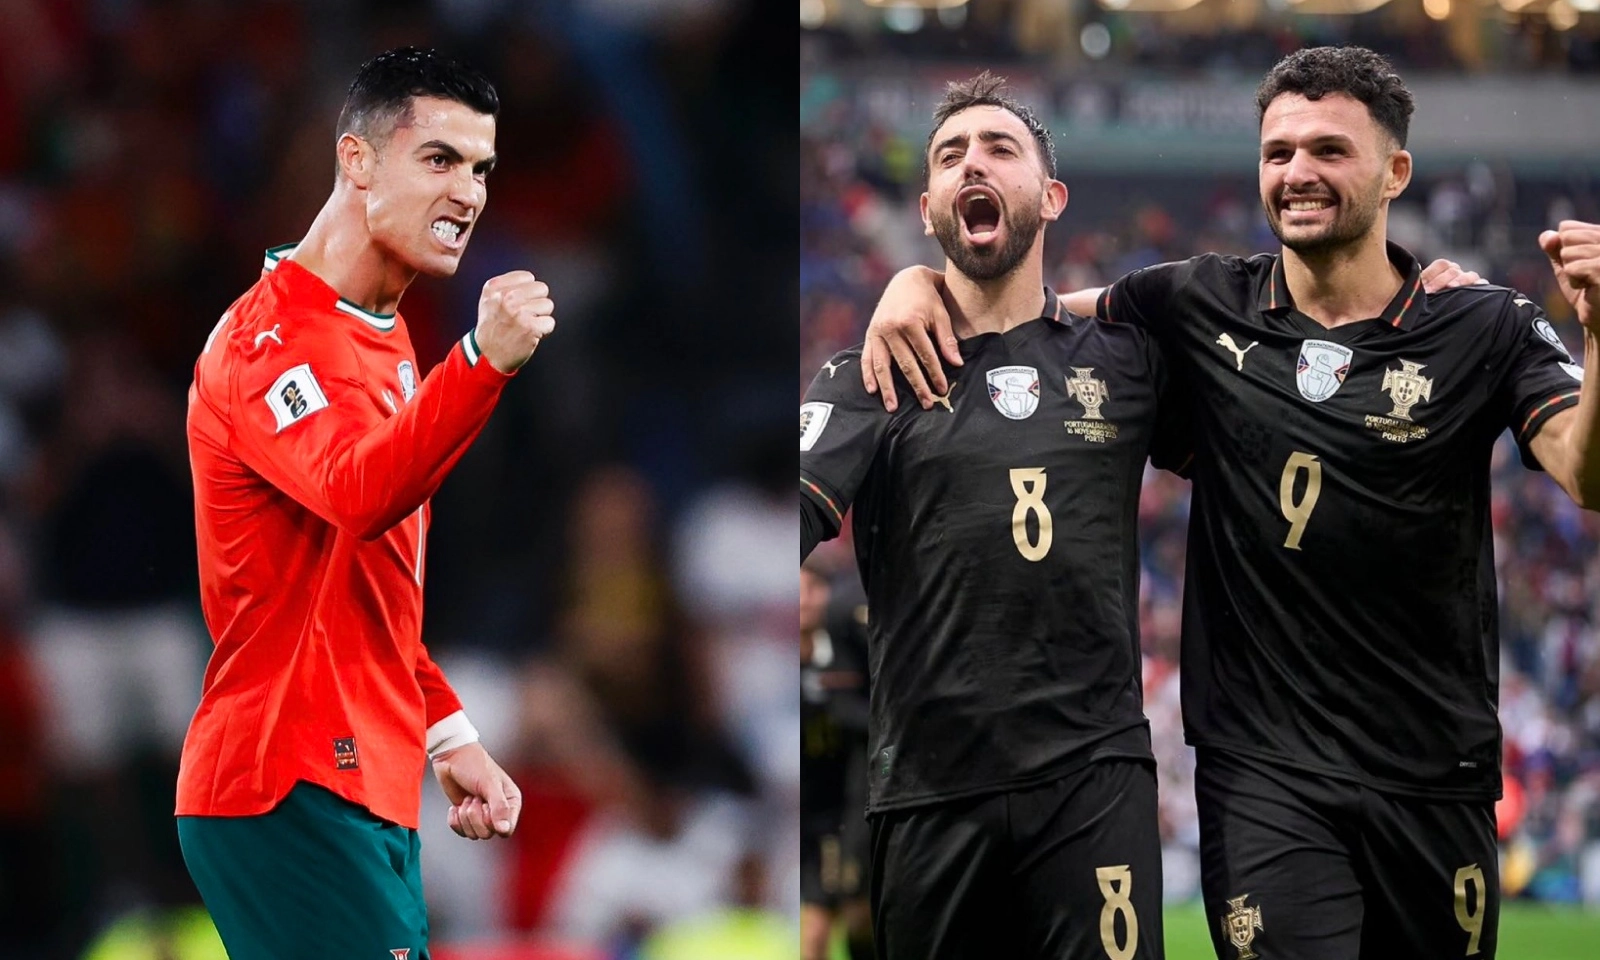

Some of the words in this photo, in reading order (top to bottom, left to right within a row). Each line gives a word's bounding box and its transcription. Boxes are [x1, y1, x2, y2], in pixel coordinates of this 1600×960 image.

[1084, 434, 1105, 443] PORTO
[1382, 431, 1407, 443] PORTO
[1010, 467, 1053, 561] 8
[1279, 452, 1322, 550] 9
[1096, 864, 1138, 960] 8
[1454, 863, 1486, 956] 9
